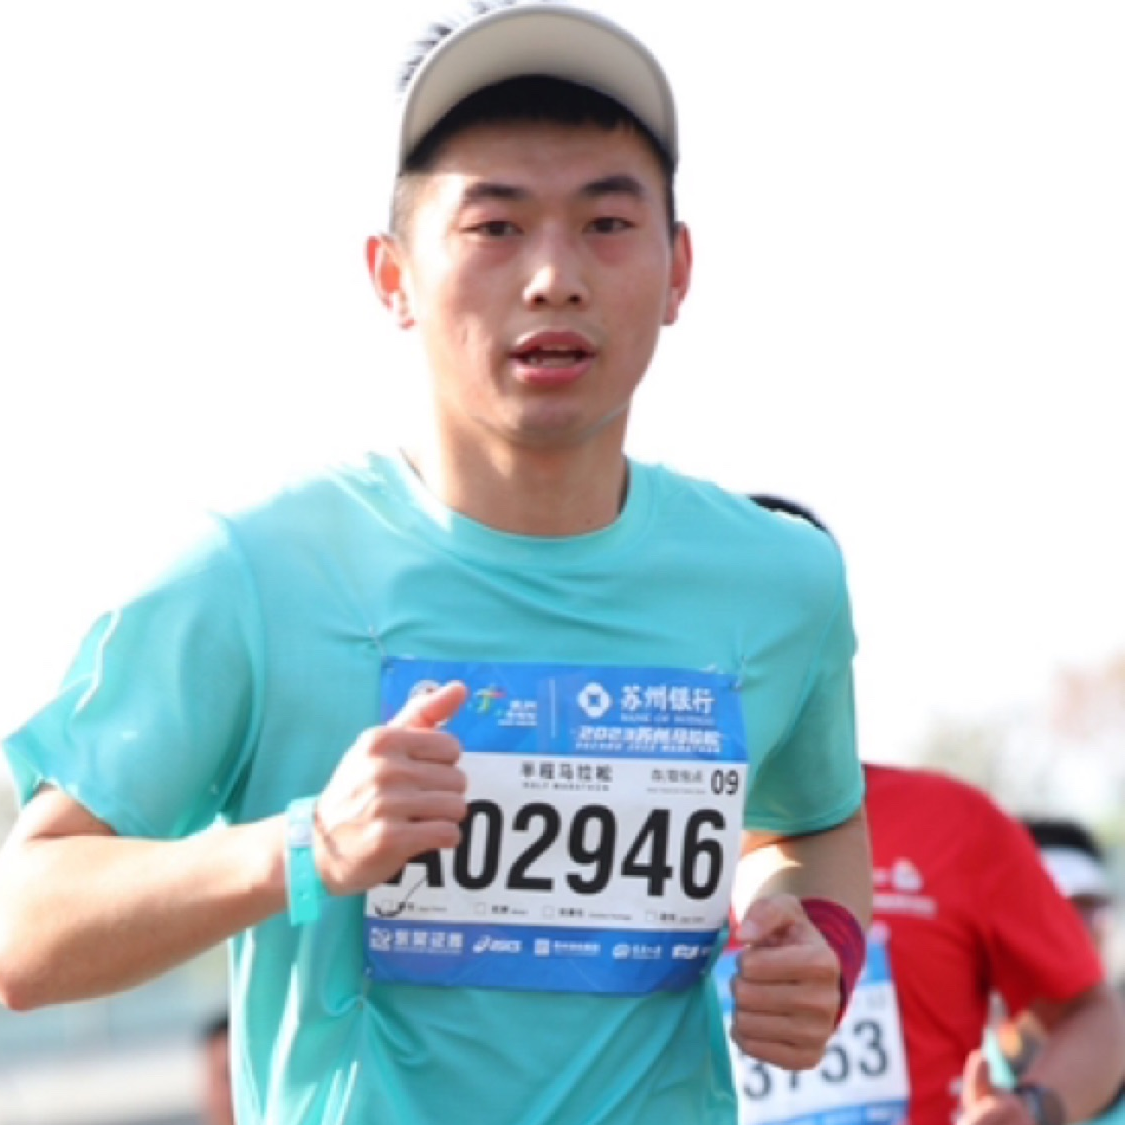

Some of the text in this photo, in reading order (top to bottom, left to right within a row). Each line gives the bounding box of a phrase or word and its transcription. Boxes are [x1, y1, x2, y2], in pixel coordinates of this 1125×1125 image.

[621, 683, 716, 714] 苏州银行
[520, 761, 613, 782] 半程马拉松
[710, 769, 739, 796] 09
